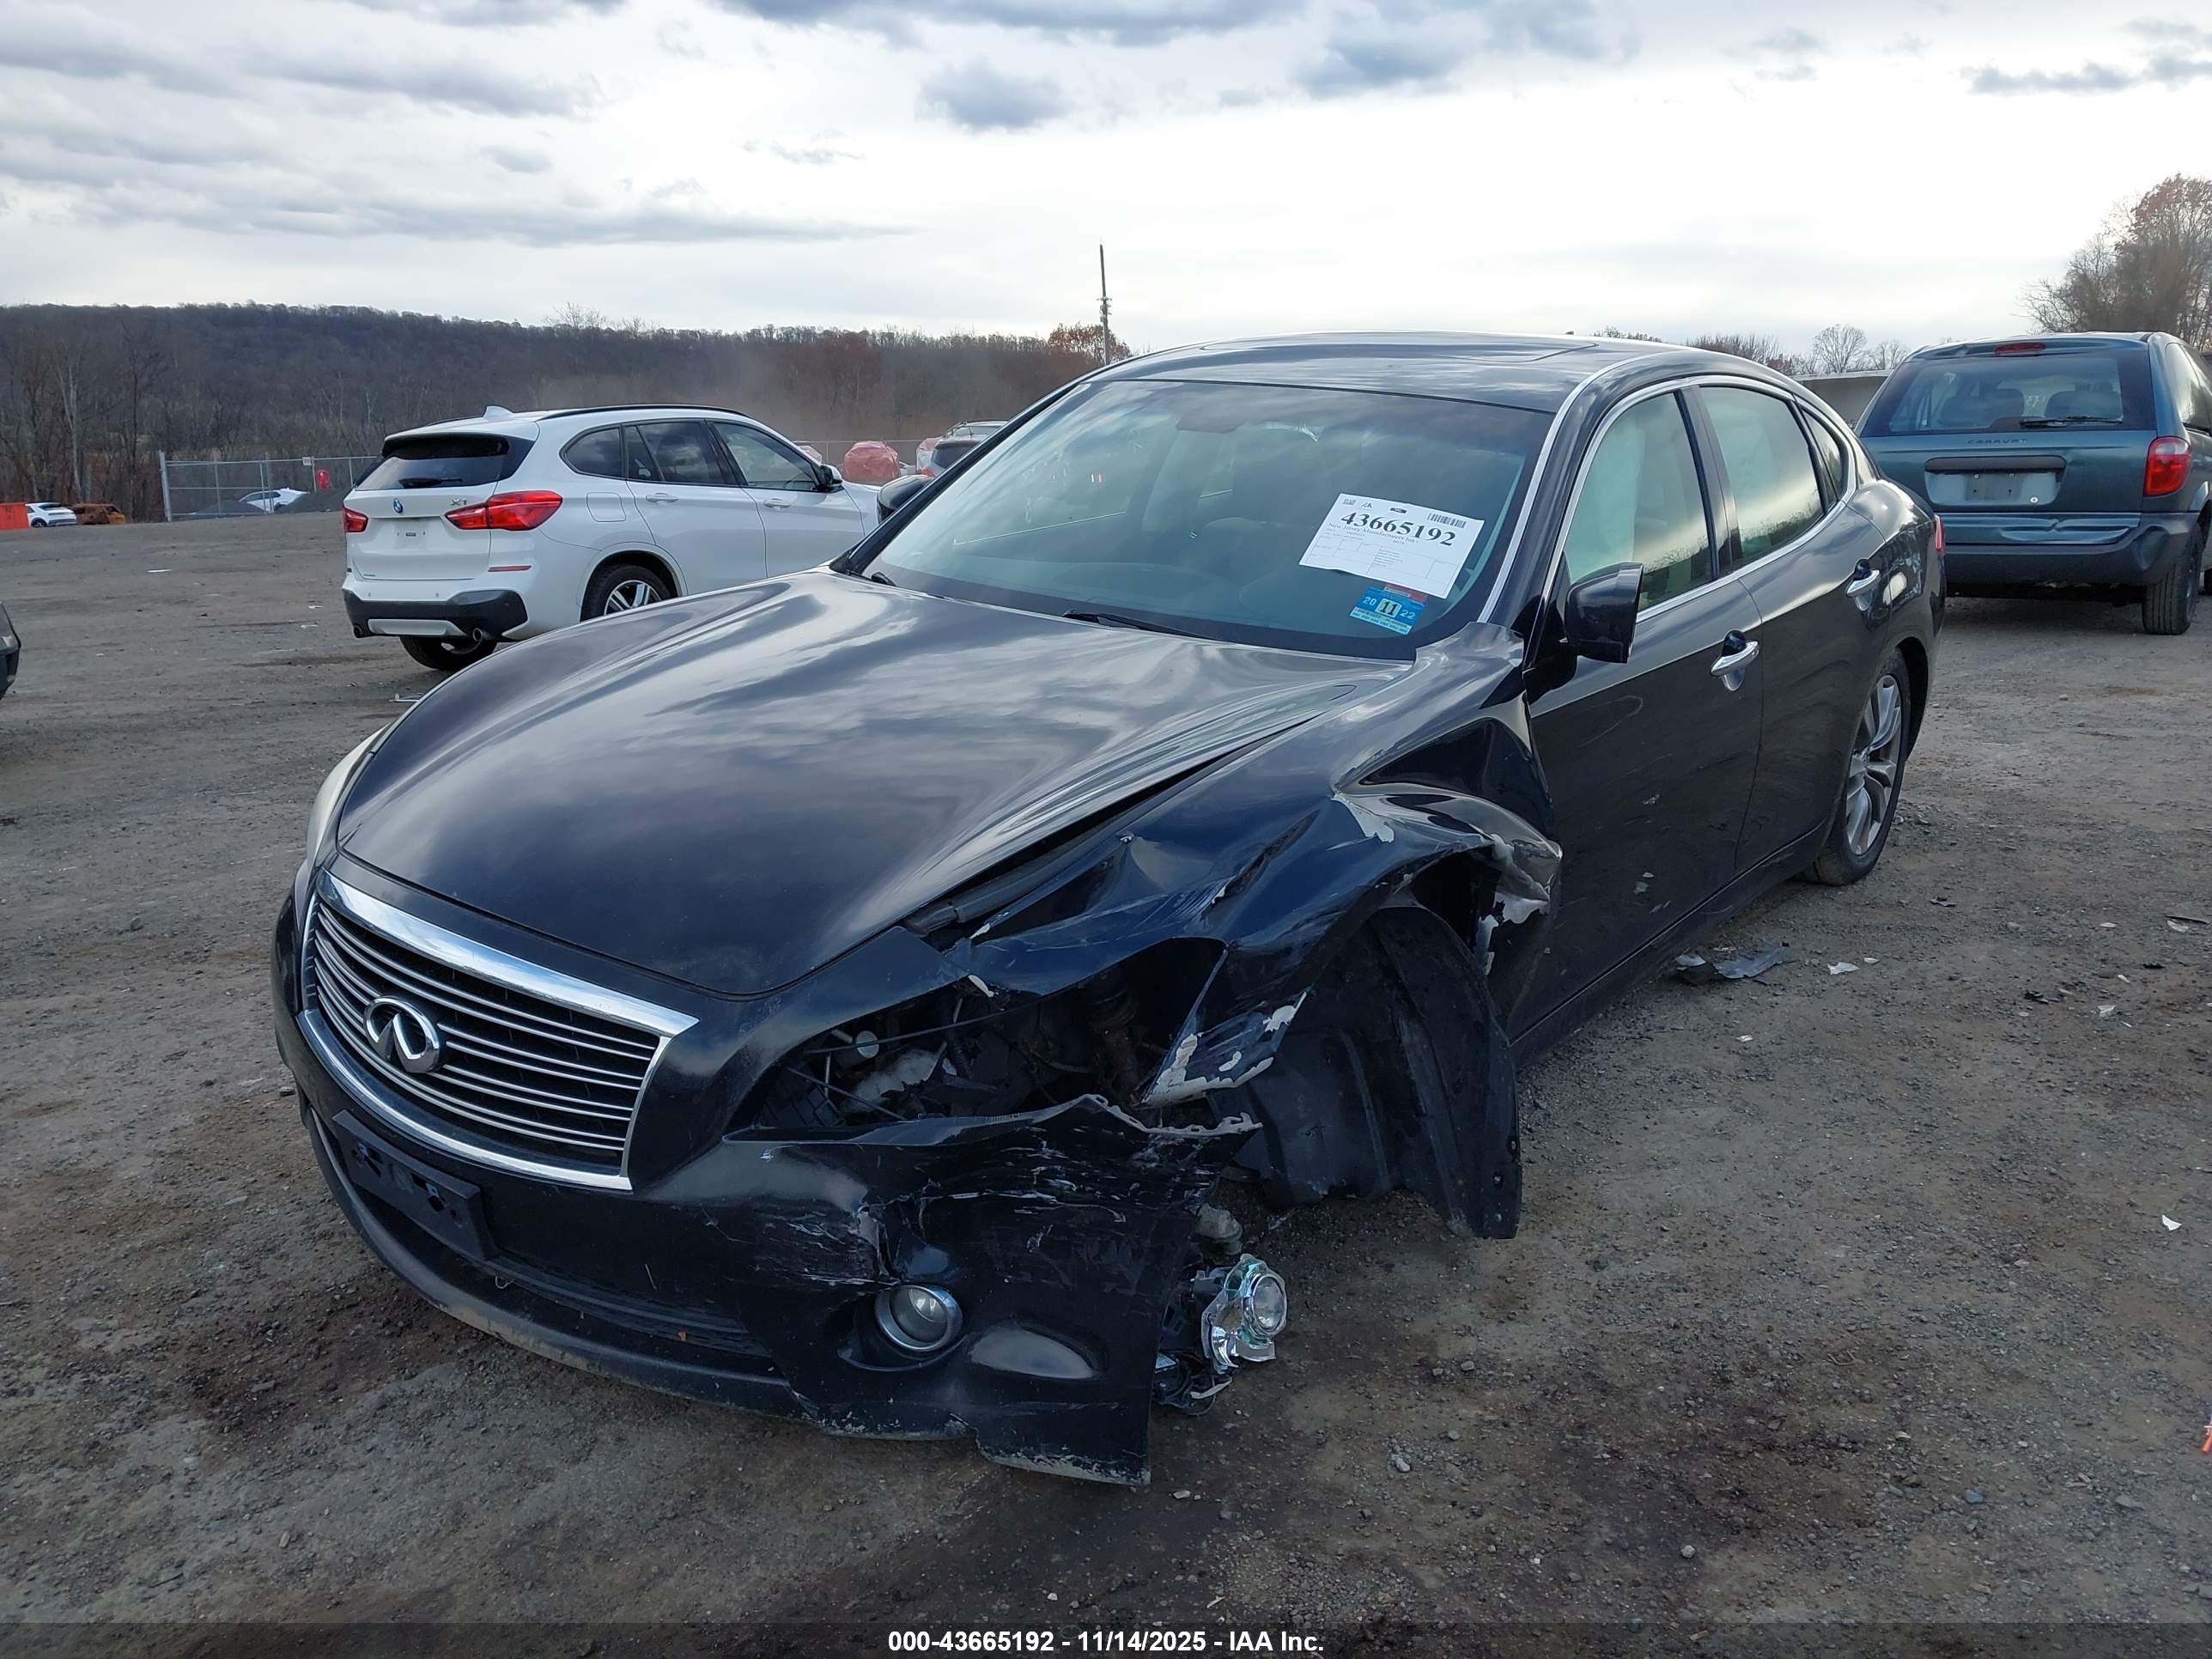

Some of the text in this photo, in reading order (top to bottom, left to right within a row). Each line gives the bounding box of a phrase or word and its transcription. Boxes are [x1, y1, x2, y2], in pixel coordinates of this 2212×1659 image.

[1340, 511, 1456, 546] 43665192
[1362, 596, 1416, 620] 20 11 22
